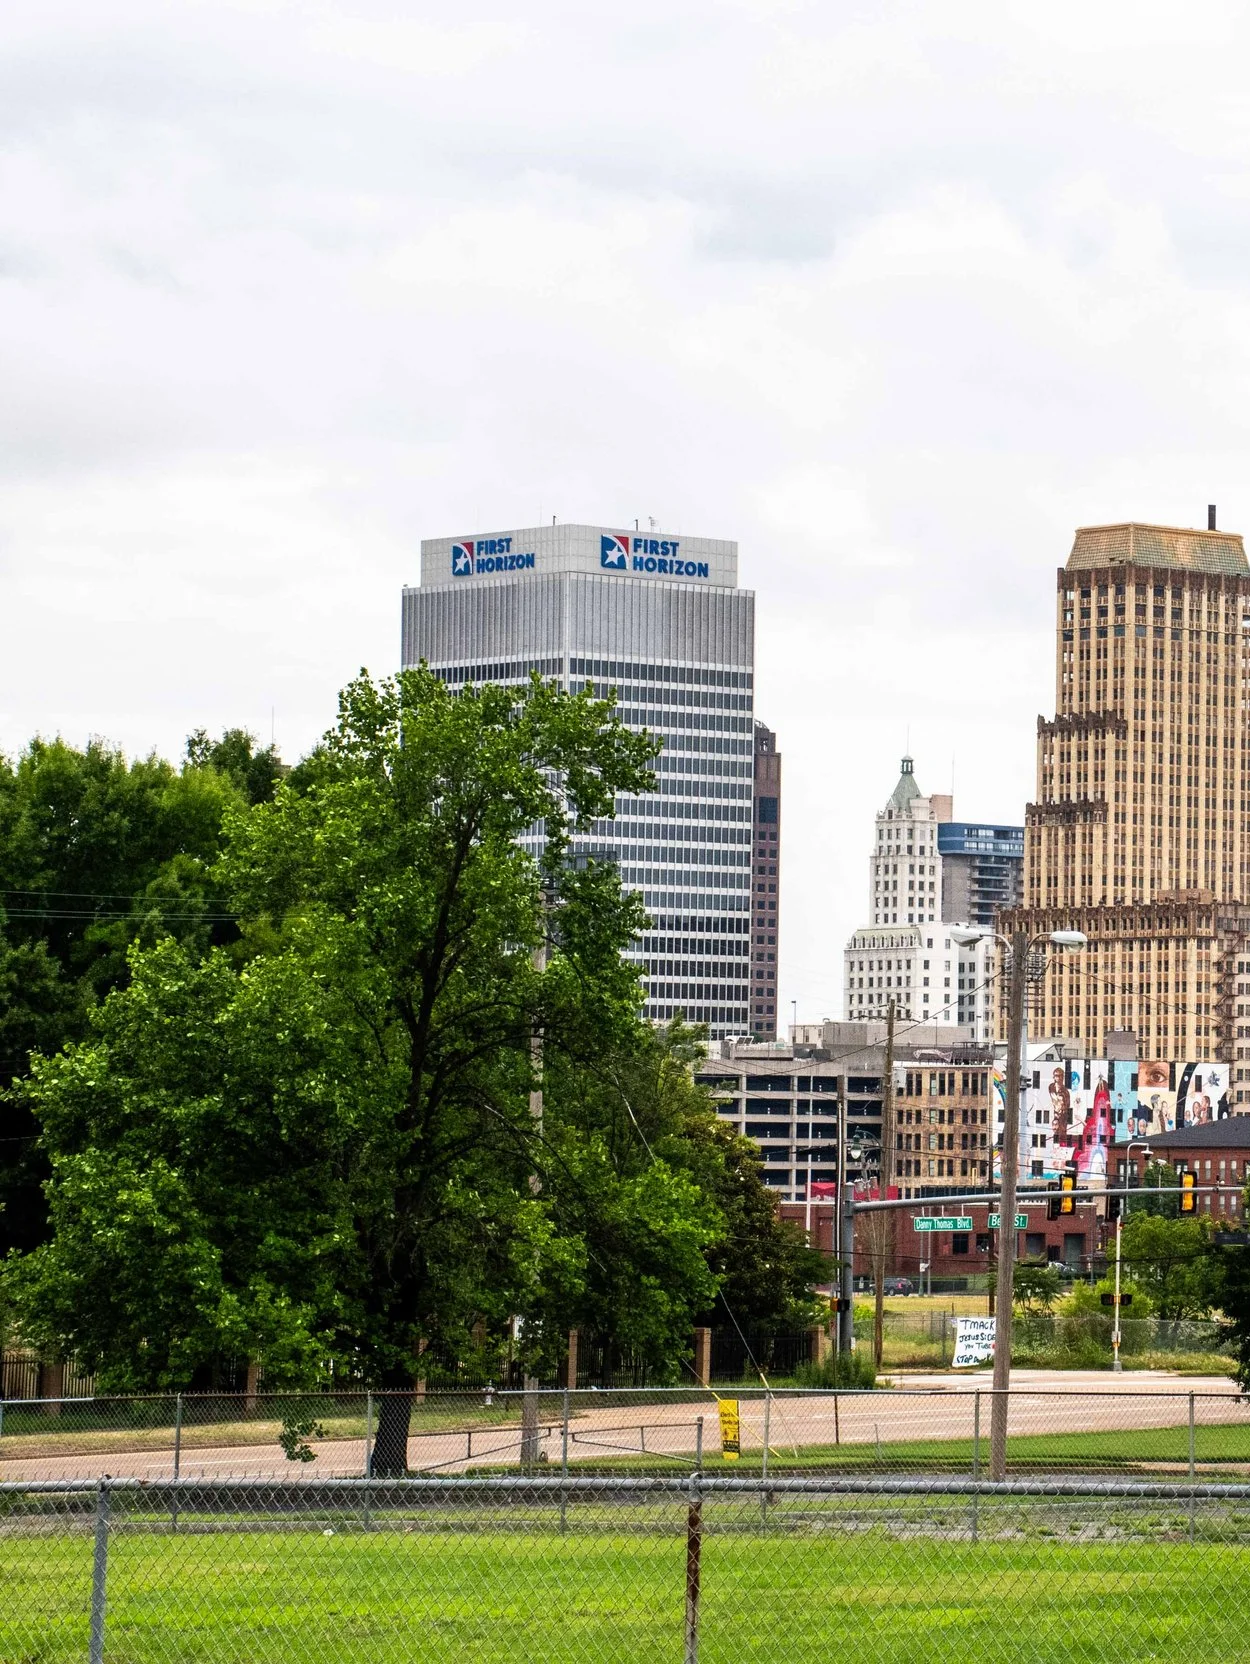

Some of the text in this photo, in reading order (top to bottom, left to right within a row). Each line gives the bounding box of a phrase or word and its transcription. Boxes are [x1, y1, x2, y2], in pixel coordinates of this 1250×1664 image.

[476, 538, 512, 556] FIRST
[633, 538, 680, 557] FIRST
[476, 553, 535, 575] HORIZON
[633, 556, 709, 578] HORIZON
[916, 1219, 932, 1231] Danny
[933, 1218, 954, 1229] Thomas
